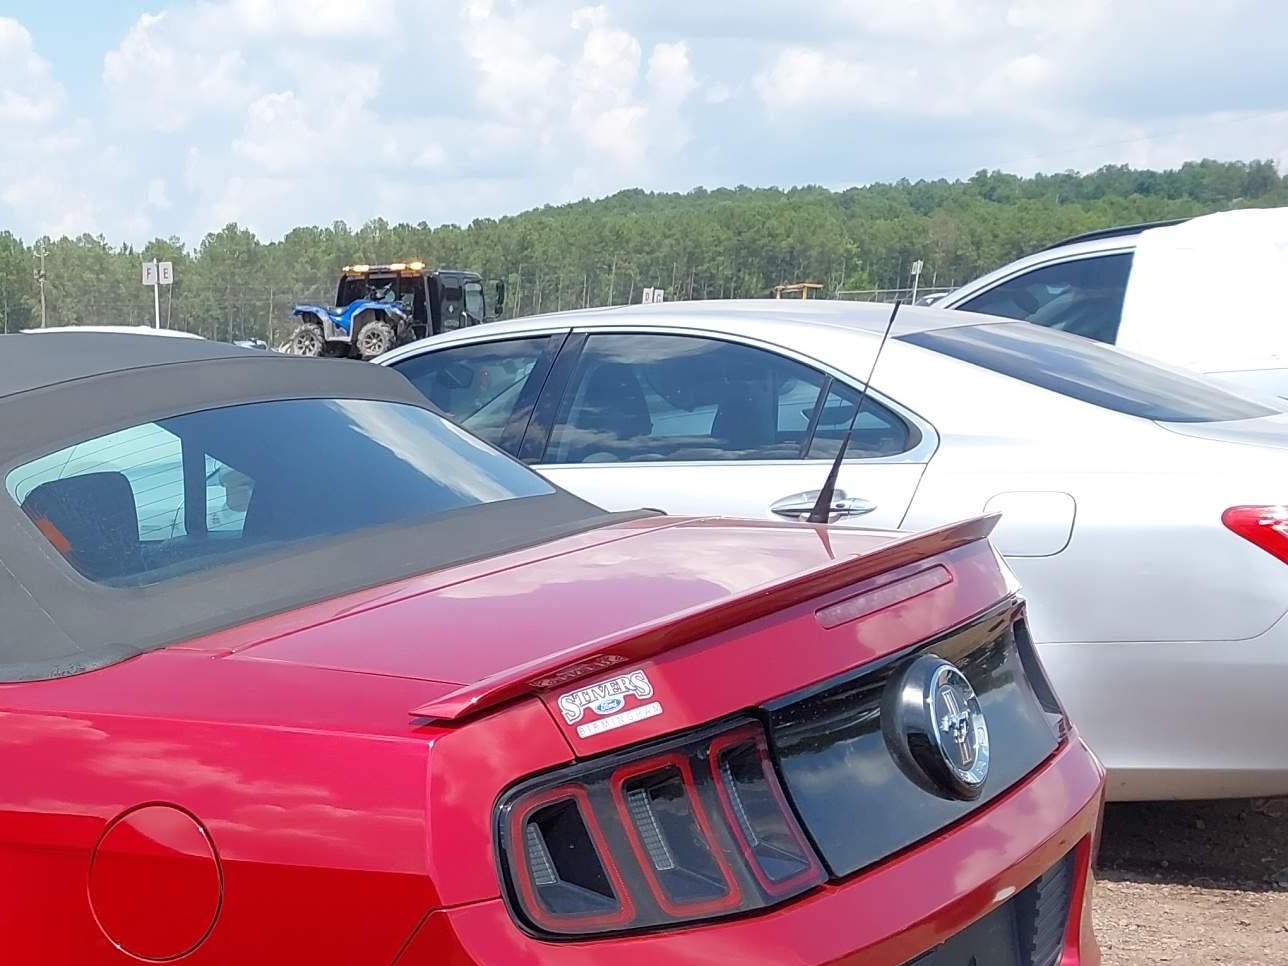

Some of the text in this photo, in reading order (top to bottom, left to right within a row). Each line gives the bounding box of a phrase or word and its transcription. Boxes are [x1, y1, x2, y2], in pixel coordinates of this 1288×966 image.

[146, 267, 152, 280] F
[163, 267, 169, 279] E
[560, 670, 651, 723] STIVERS
[579, 704, 660, 737] BIRMINGHAM
